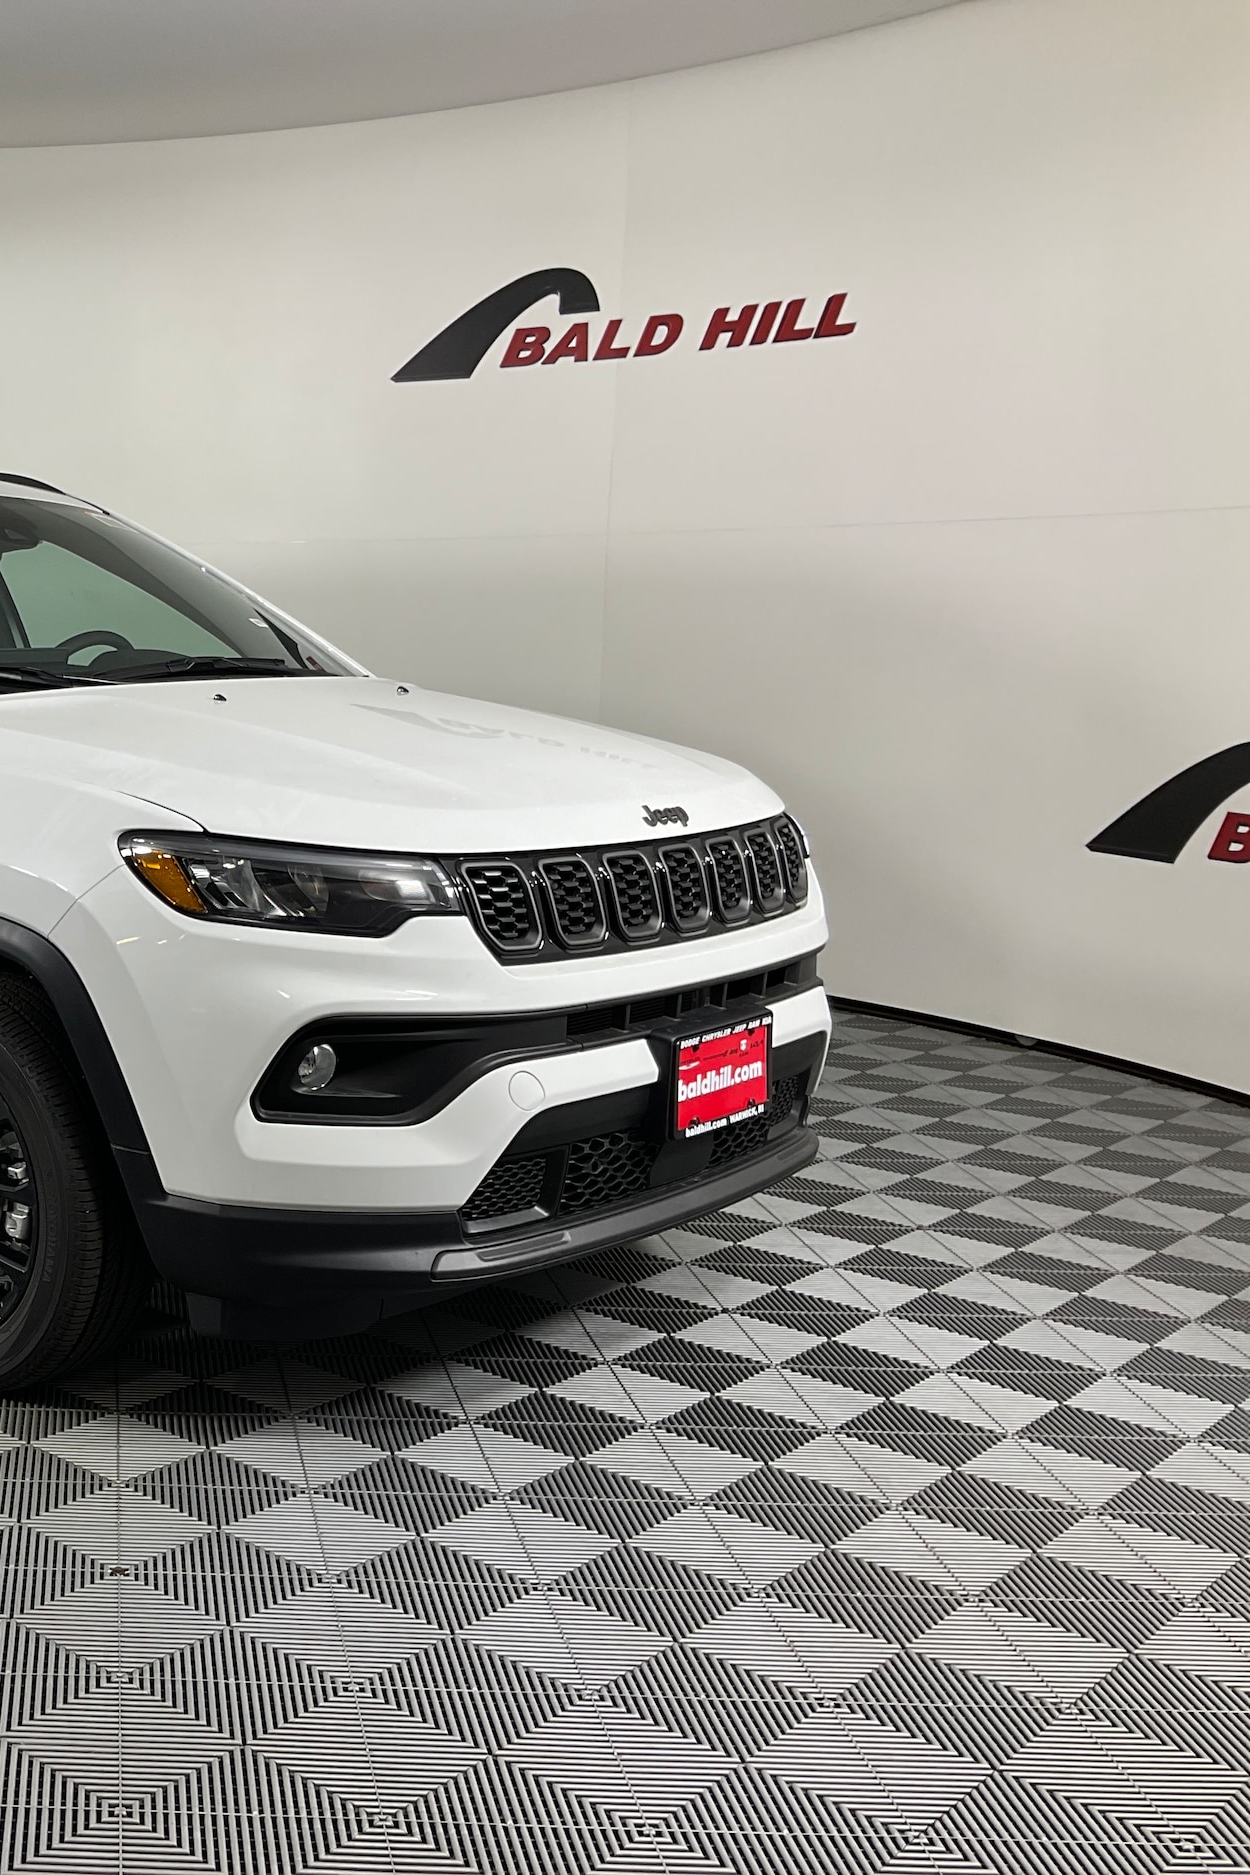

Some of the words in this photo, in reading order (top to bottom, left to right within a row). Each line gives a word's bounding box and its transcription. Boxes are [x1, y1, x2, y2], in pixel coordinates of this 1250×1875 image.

[500, 313, 684, 368] BALD
[699, 292, 857, 351] HILL
[641, 805, 690, 828] Jeep
[680, 1036, 700, 1050] DODGE
[701, 1028, 732, 1042] CHRYSLER
[732, 1023, 748, 1034] JEEP
[747, 1019, 761, 1030] RAM
[762, 1016, 772, 1025] KIA
[678, 1061, 763, 1103] baldhill.com
[685, 1117, 728, 1138] baldhill.com
